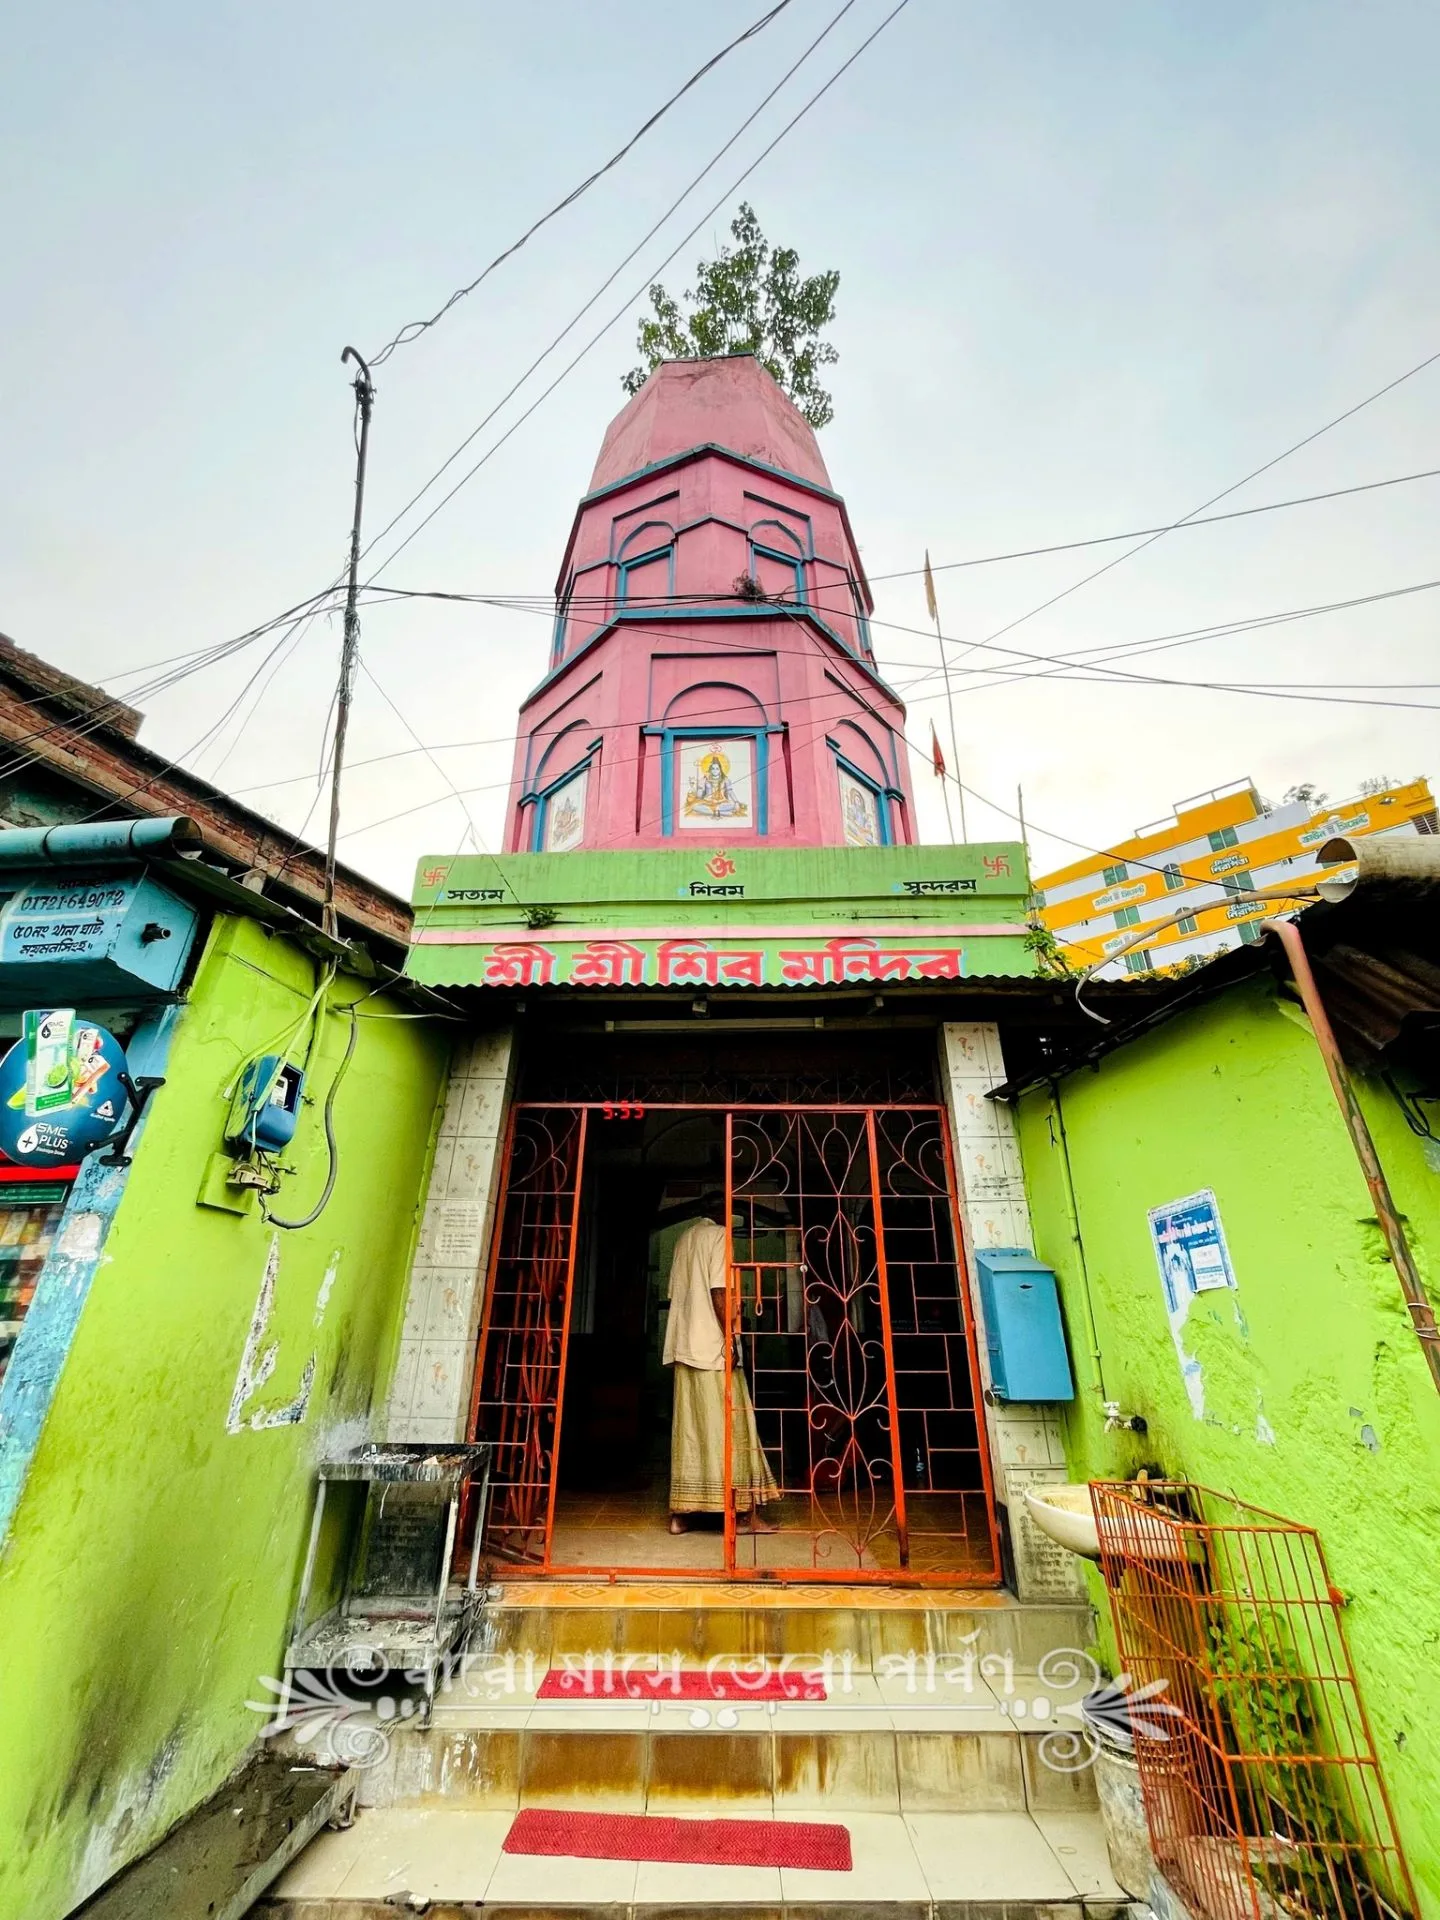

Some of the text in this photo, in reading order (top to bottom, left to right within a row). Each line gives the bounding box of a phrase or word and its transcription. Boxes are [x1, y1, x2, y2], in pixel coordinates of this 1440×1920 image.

[482, 938, 962, 986] শ্রী শ্রী শিব মন্দির
[39, 1135, 69, 1149] PLUS
